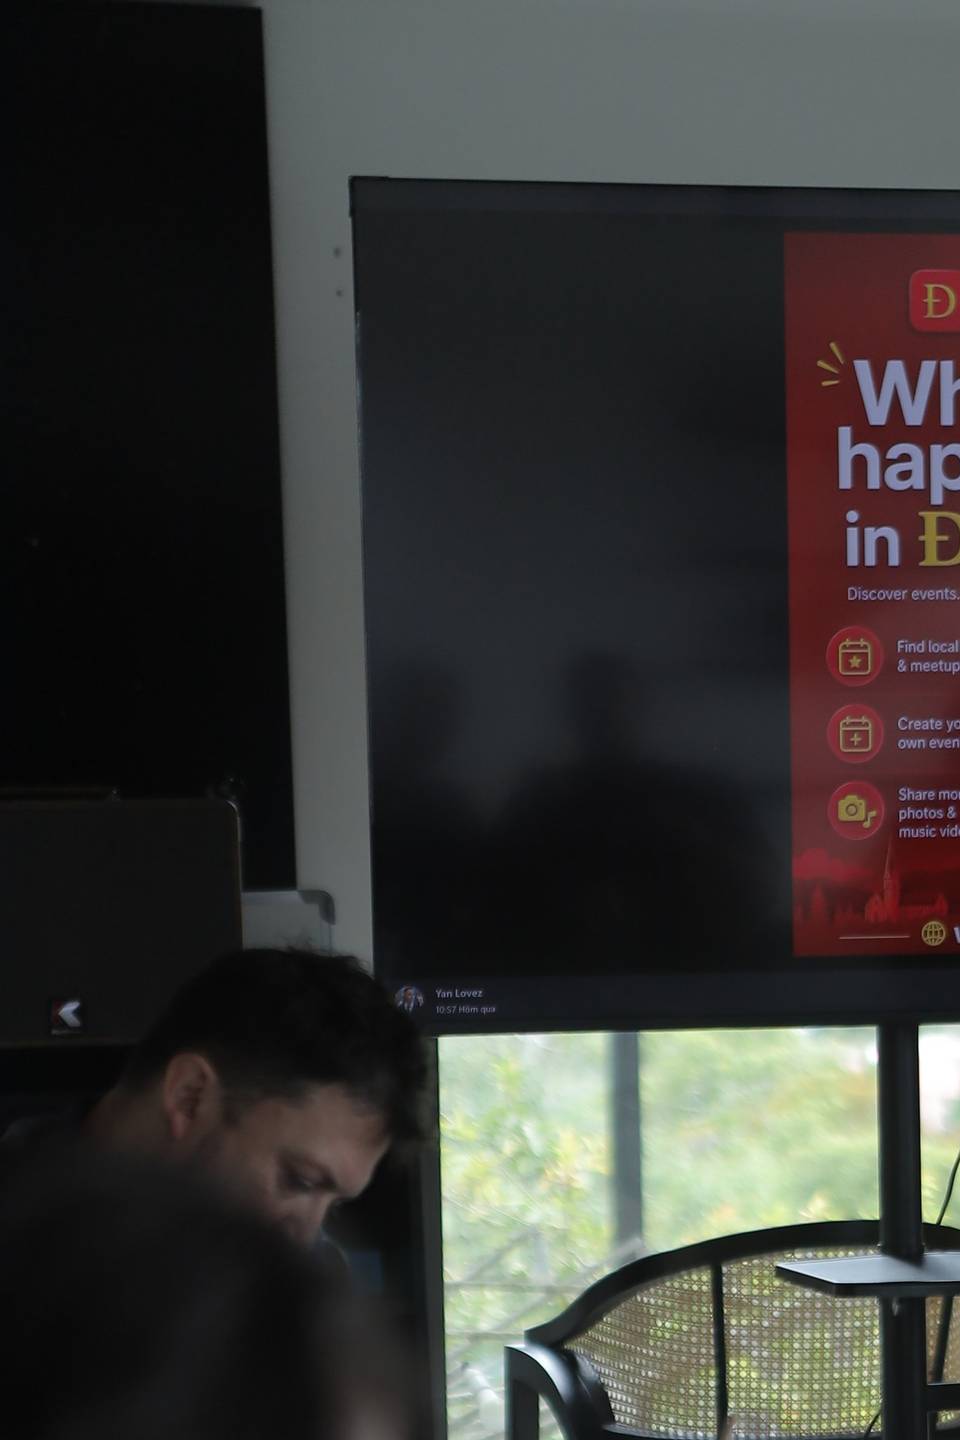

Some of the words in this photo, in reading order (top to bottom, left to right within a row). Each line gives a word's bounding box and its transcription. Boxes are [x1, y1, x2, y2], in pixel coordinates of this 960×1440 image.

[845, 510, 901, 568] in
[847, 586, 908, 601] Discover
[911, 587, 960, 601] events.
[897, 640, 925, 654] Find
[927, 639, 958, 654] local
[897, 659, 907, 673] &
[897, 716, 943, 731] Create
[898, 738, 926, 750] own
[898, 787, 936, 801] Share
[898, 806, 944, 823] photos
[946, 806, 957, 819] &
[899, 825, 937, 839] music
[436, 988, 453, 998] Yan
